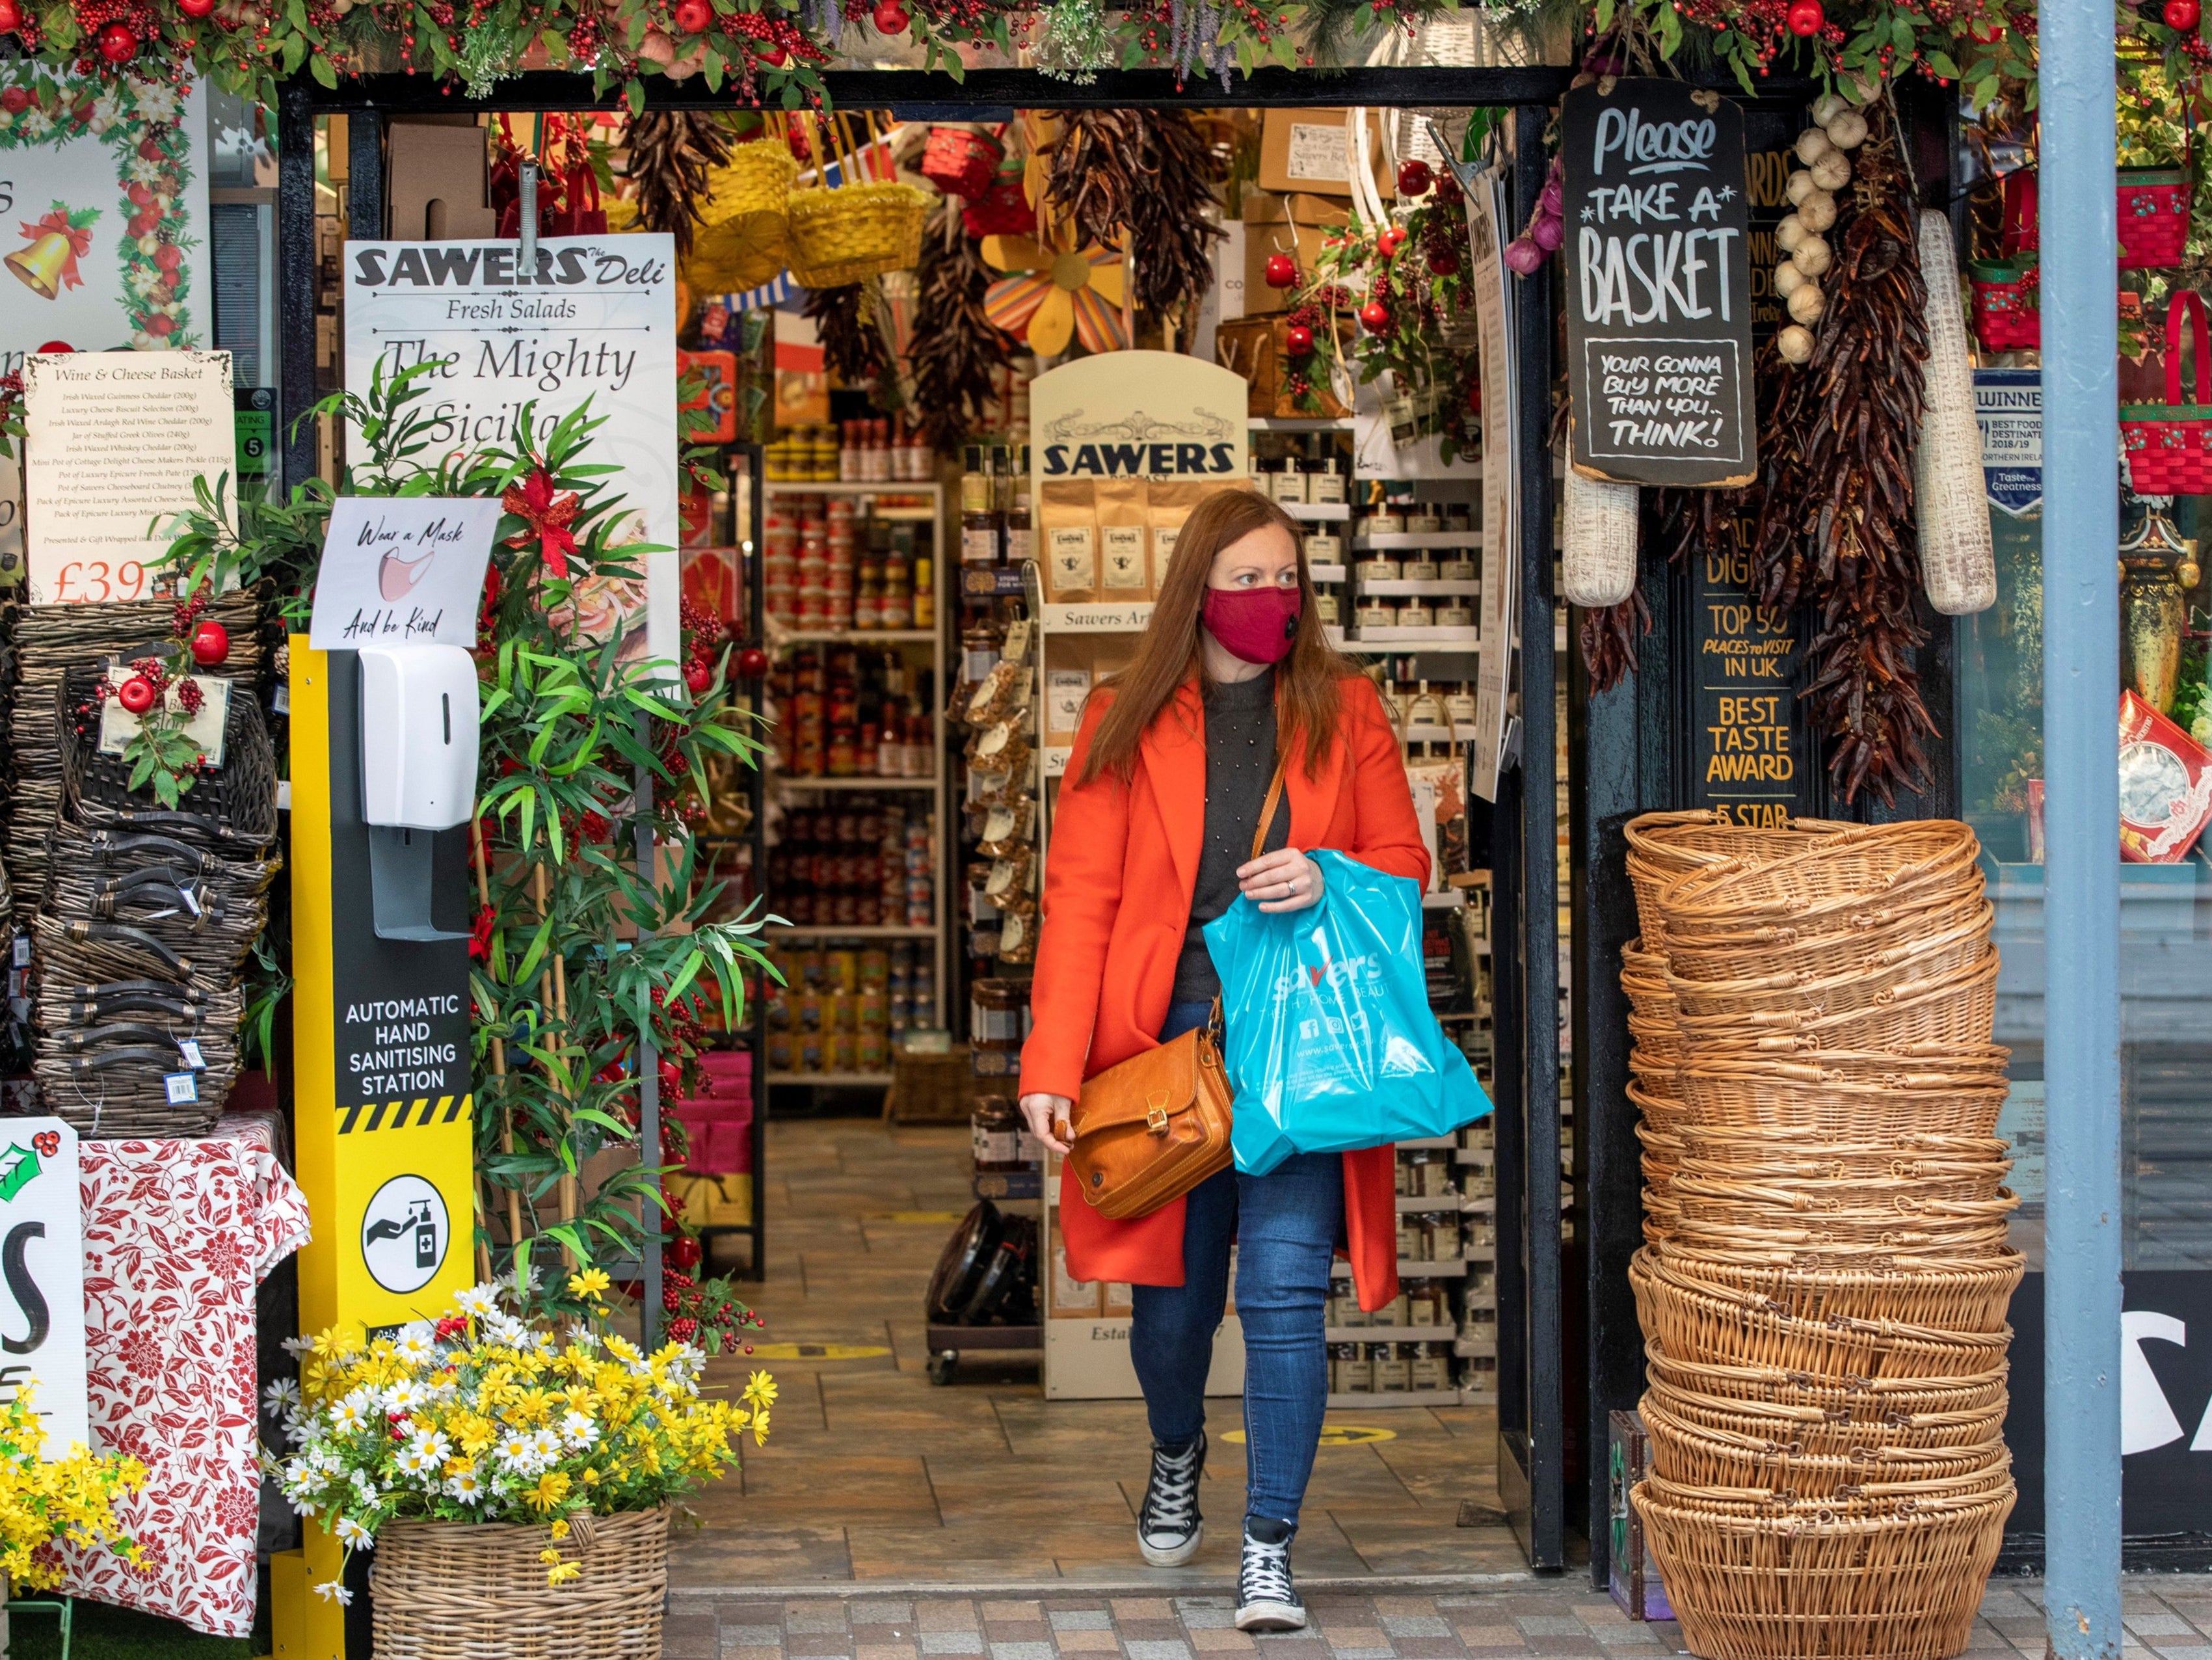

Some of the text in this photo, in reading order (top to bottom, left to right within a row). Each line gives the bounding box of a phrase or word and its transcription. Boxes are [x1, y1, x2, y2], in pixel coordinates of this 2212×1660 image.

[1594, 107, 1716, 175] Please
[1588, 182, 1722, 224] TAKE A
[355, 247, 587, 286] SAWERS
[596, 254, 666, 286] Deli
[1579, 226, 1739, 327] BASKET
[446, 299, 576, 319] Fresh Salads
[56, 368, 203, 381] Wine & Cheese Basket
[380, 338, 637, 392] The Mighty
[1601, 355, 1722, 375] YOUR GONNA
[1603, 375, 1723, 397] BUY MORE
[1606, 397, 1662, 416] THAN
[1977, 392, 2042, 407] WINNE
[62, 407, 88, 415] Luxury
[236, 416, 265, 424] ATING
[1608, 418, 1724, 448] THINK!
[1992, 420, 2042, 429] BEST FOOD
[1992, 430, 2042, 438] DESTINATI
[248, 440, 260, 455] 5
[1992, 440, 2029, 448] 2018/19
[1043, 443, 1234, 475] SAWERS
[81, 471, 108, 479] Luxury
[1998, 473, 2026, 482] Taste
[1992, 482, 2042, 491] Greatness
[55, 498, 62, 506] of
[105, 535, 137, 544] Wrapped
[357, 516, 464, 546] Wear a Mask
[343, 607, 443, 639] And be Kind
[1065, 611, 1122, 626] Sawers
[1707, 605, 1752, 636] TOP
[1703, 639, 1750, 654] PLACES
[1763, 639, 1794, 654] VISIT
[1725, 658, 1784, 678] IN UK.
[1719, 697, 1779, 725] BEST
[1707, 726, 1789, 753] TASTE
[1706, 754, 1794, 783] AWARD
[1737, 804, 1789, 831] STAR
[1272, 952, 1382, 1001] savers
[345, 995, 459, 1024] AUTOMATIC
[375, 1022, 430, 1045] HAND
[349, 1043, 456, 1073] SANITISING
[361, 1069, 444, 1095] STATION
